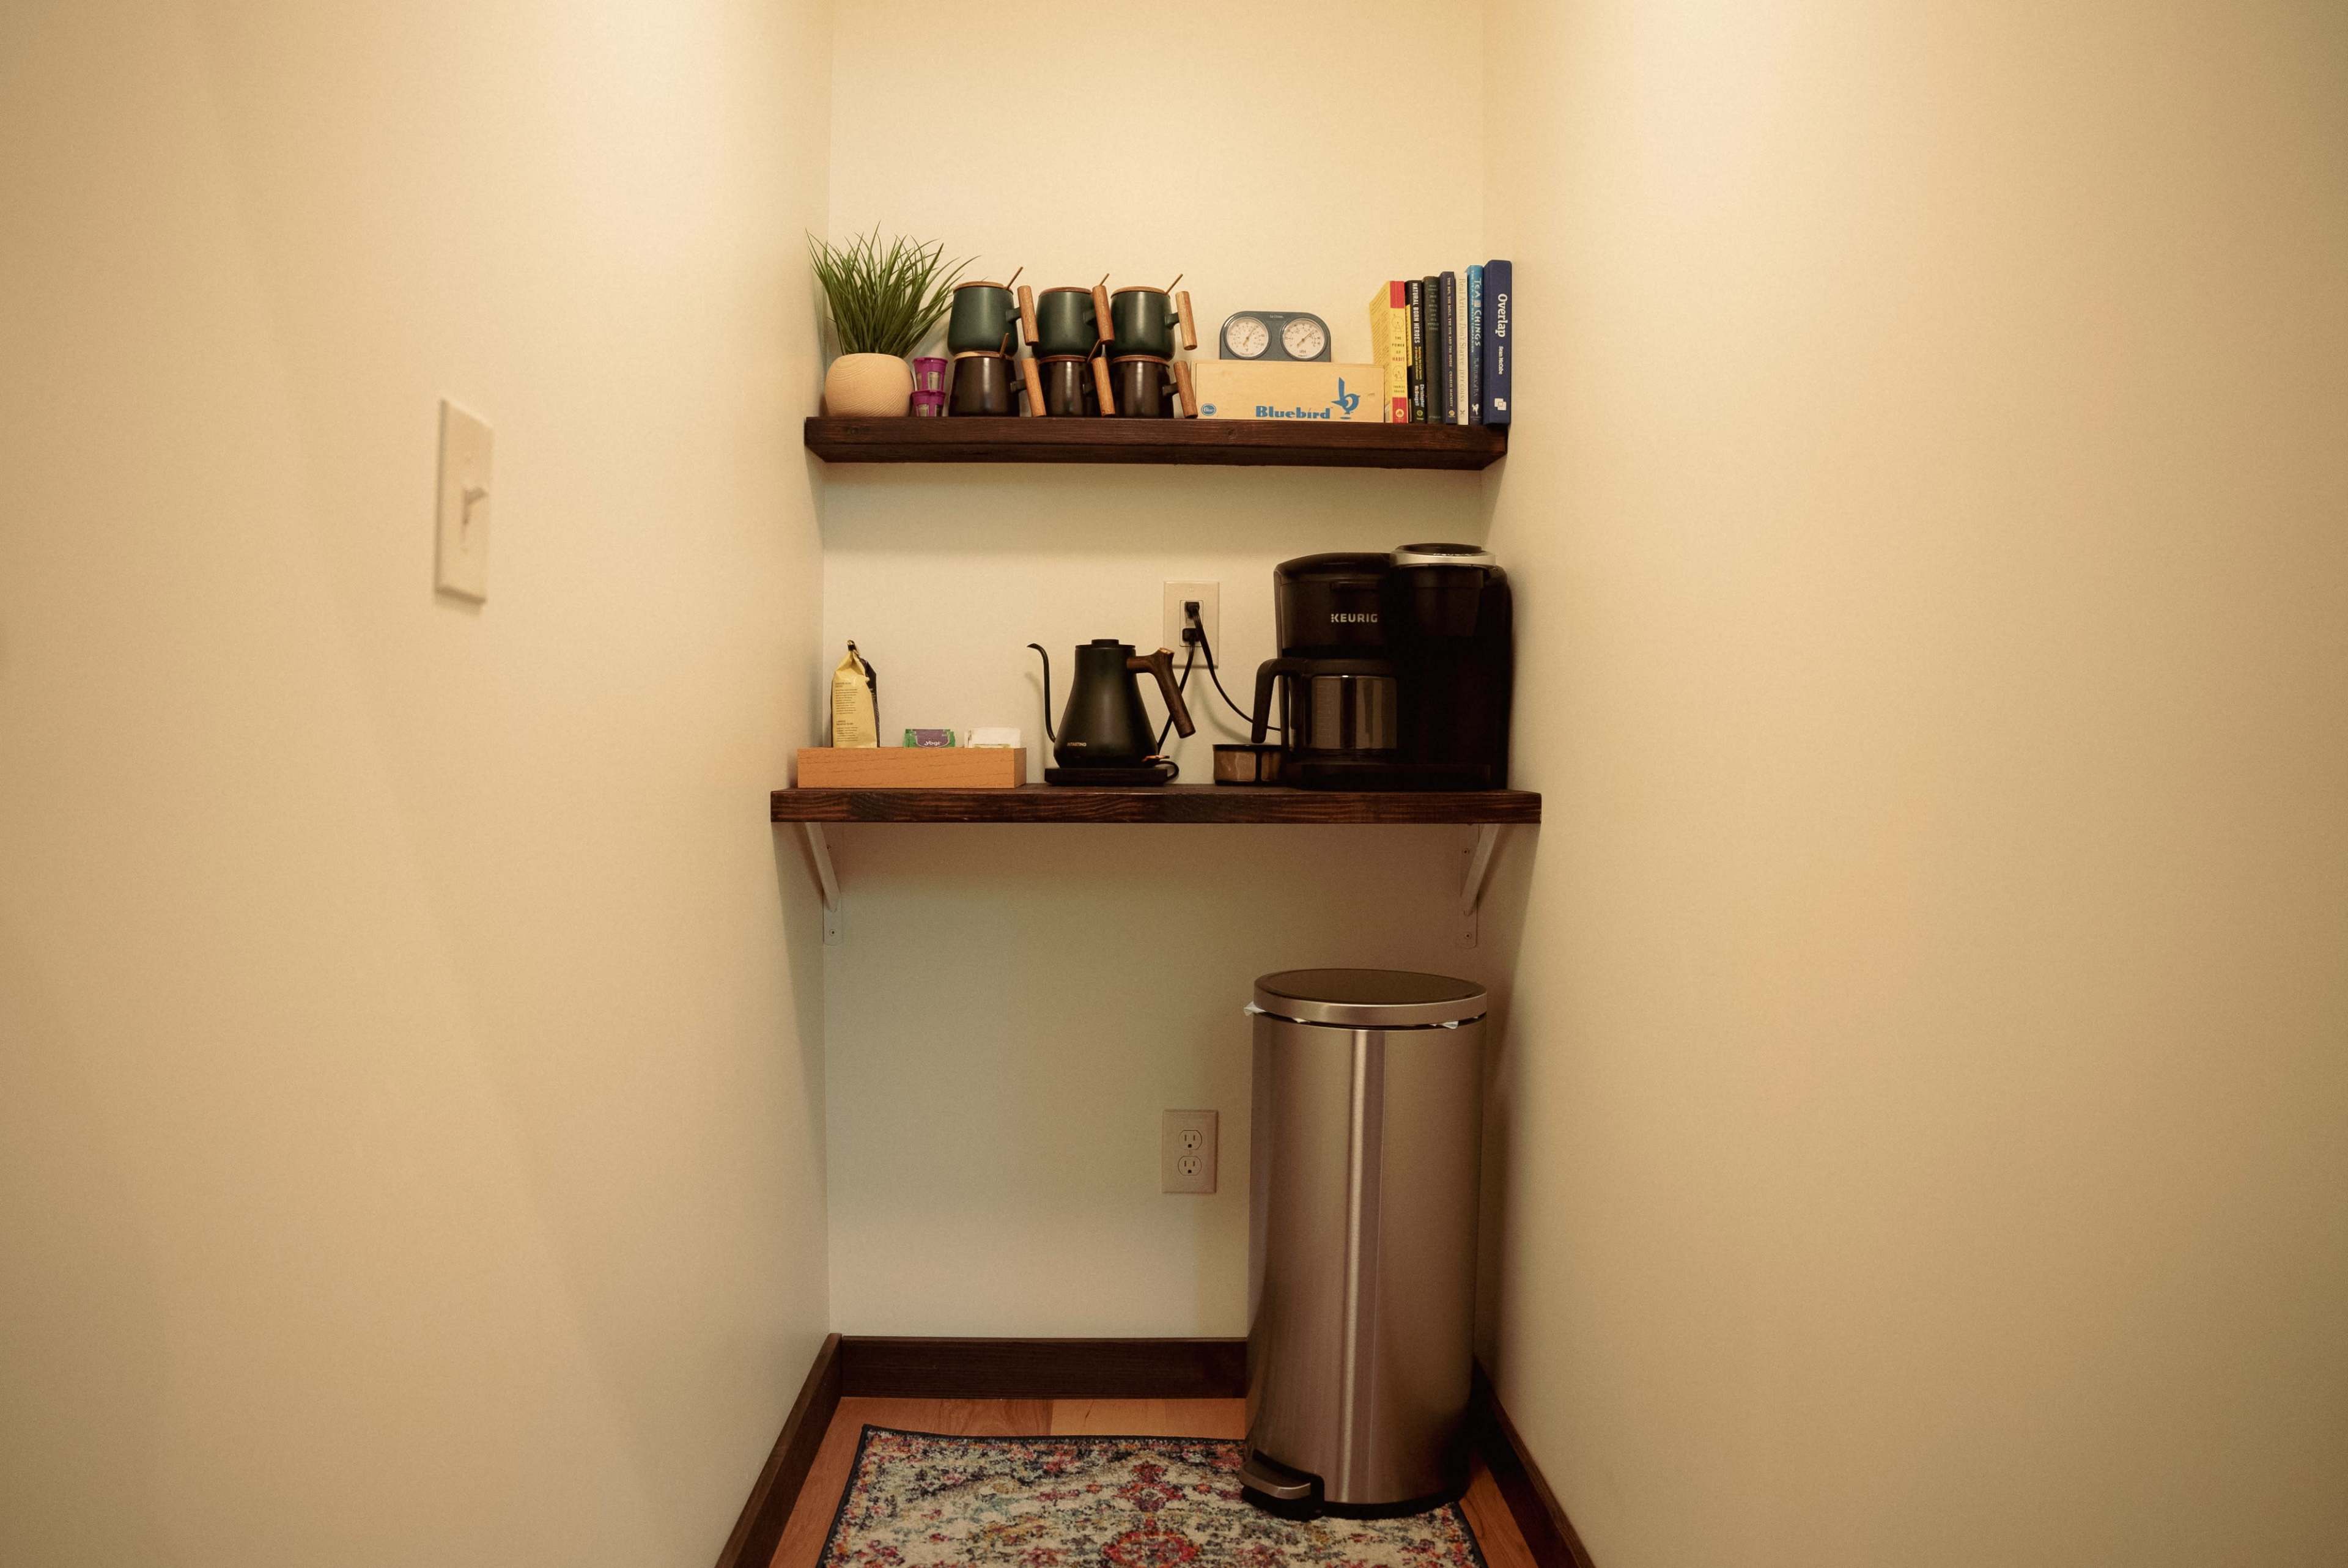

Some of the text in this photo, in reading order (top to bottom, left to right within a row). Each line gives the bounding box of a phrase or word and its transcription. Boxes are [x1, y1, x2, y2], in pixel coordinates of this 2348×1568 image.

[1495, 293, 1508, 337] Overlap
[1255, 405, 1331, 419] Bluebird
[1331, 613, 1378, 623] KEURIG
